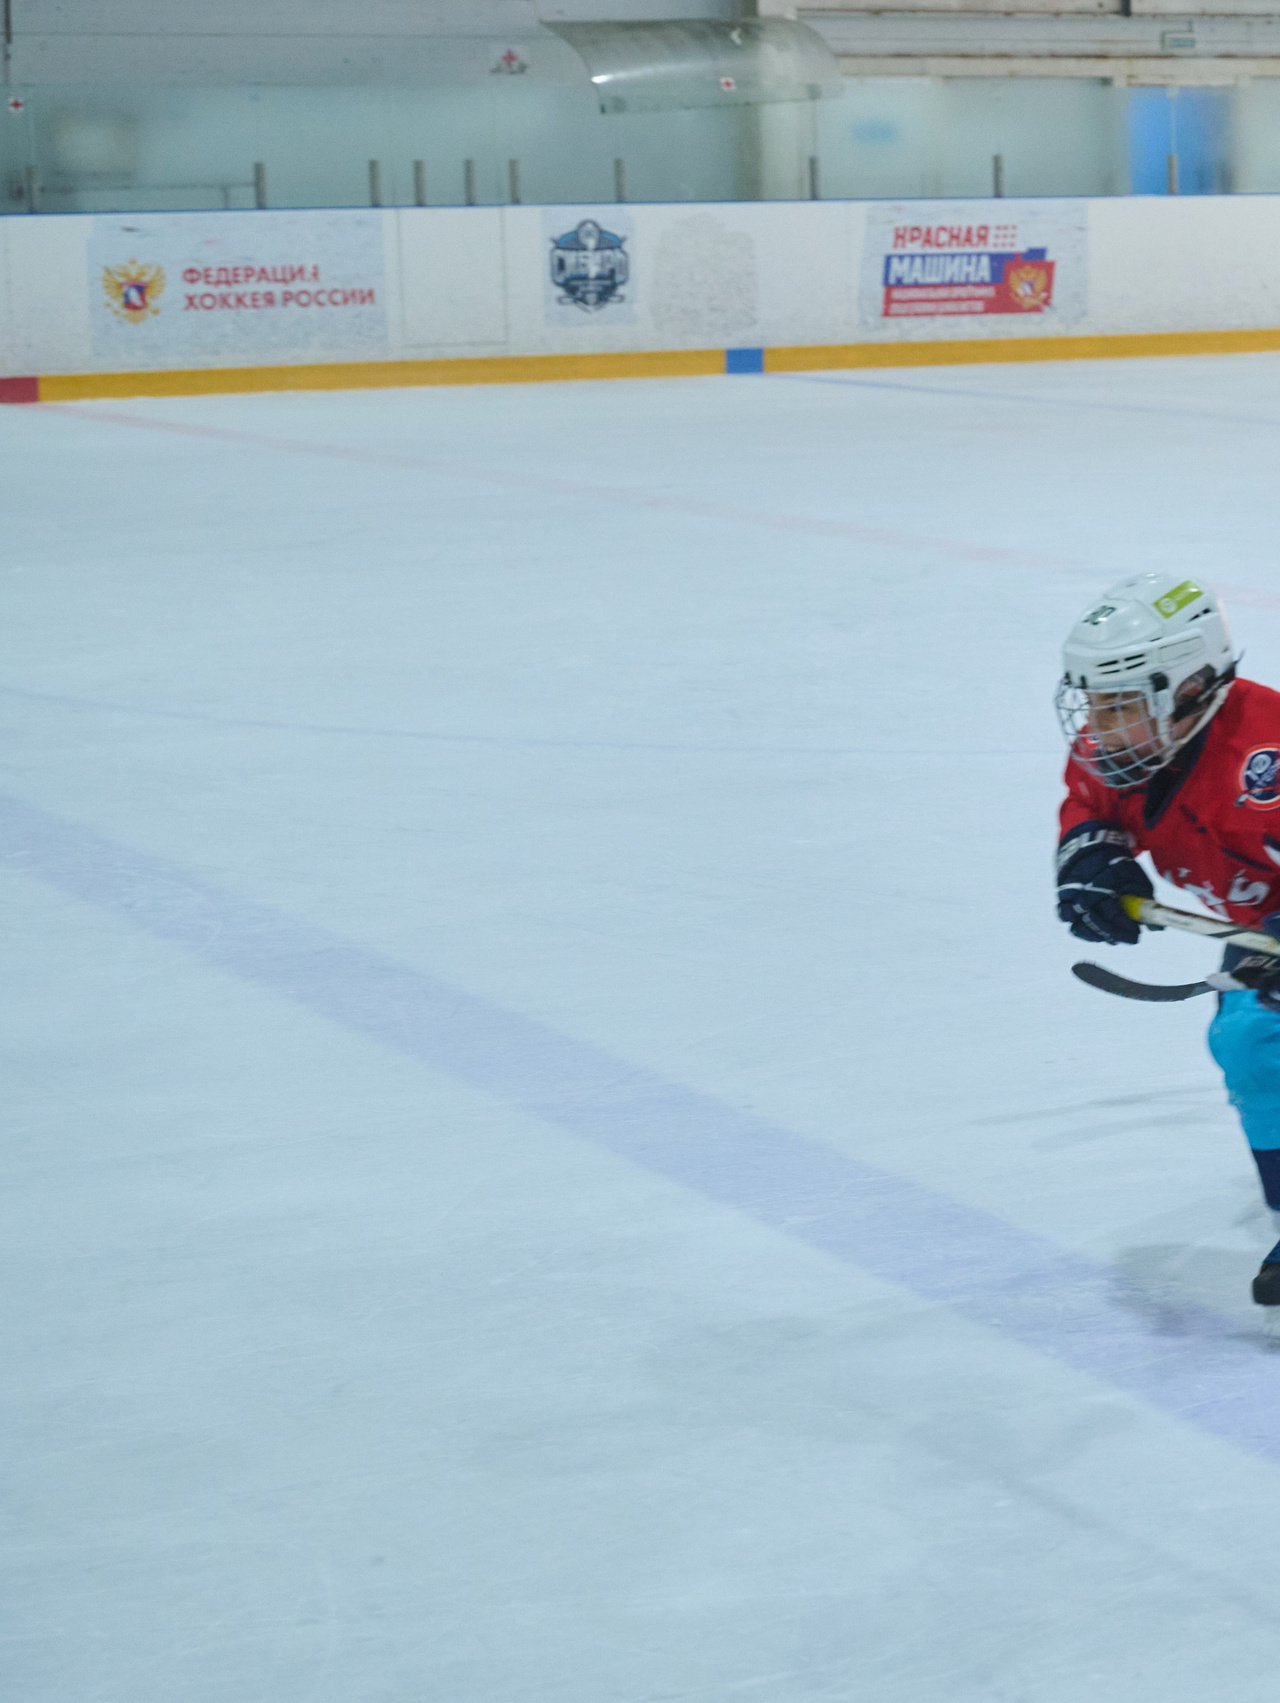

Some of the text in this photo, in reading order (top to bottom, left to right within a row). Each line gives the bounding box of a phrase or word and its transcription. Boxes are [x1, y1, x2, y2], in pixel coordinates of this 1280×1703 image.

[887, 254, 992, 285] МАШИНА
[183, 288, 375, 312] ХОККЕЯ РОССИИ
